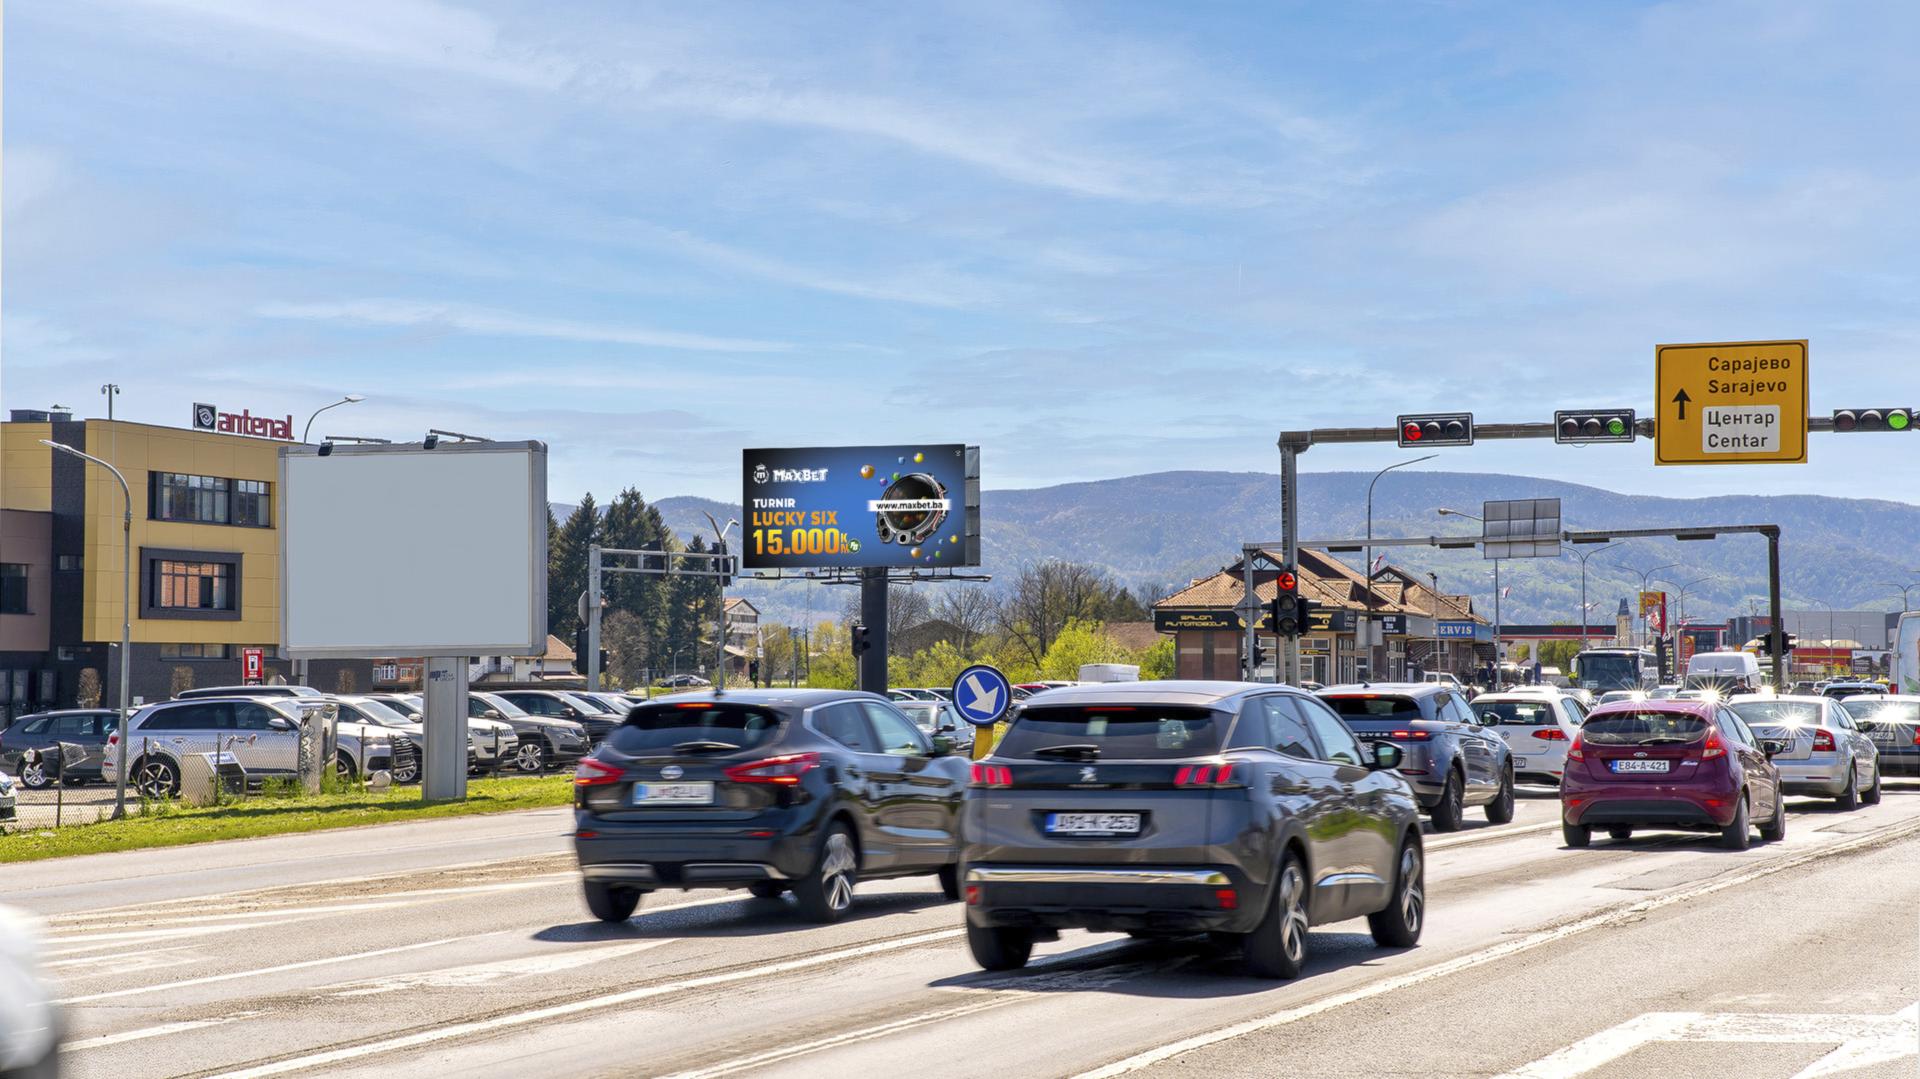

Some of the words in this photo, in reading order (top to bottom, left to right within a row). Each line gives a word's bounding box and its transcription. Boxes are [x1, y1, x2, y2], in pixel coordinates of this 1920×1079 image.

[1708, 357, 1791, 374] Сарајево
[1708, 380, 1787, 396] Sarajevo
[218, 409, 295, 440] antenal
[1708, 411, 1775, 428] Центар
[1708, 433, 1768, 448] Centar
[753, 498, 796, 509] TURNIR
[876, 500, 943, 510] www.maxbet.ba
[753, 511, 806, 526] LUCKY
[811, 511, 838, 526] SIX
[753, 528, 840, 555] 15.000
[1619, 761, 1667, 770] E84-A-421
